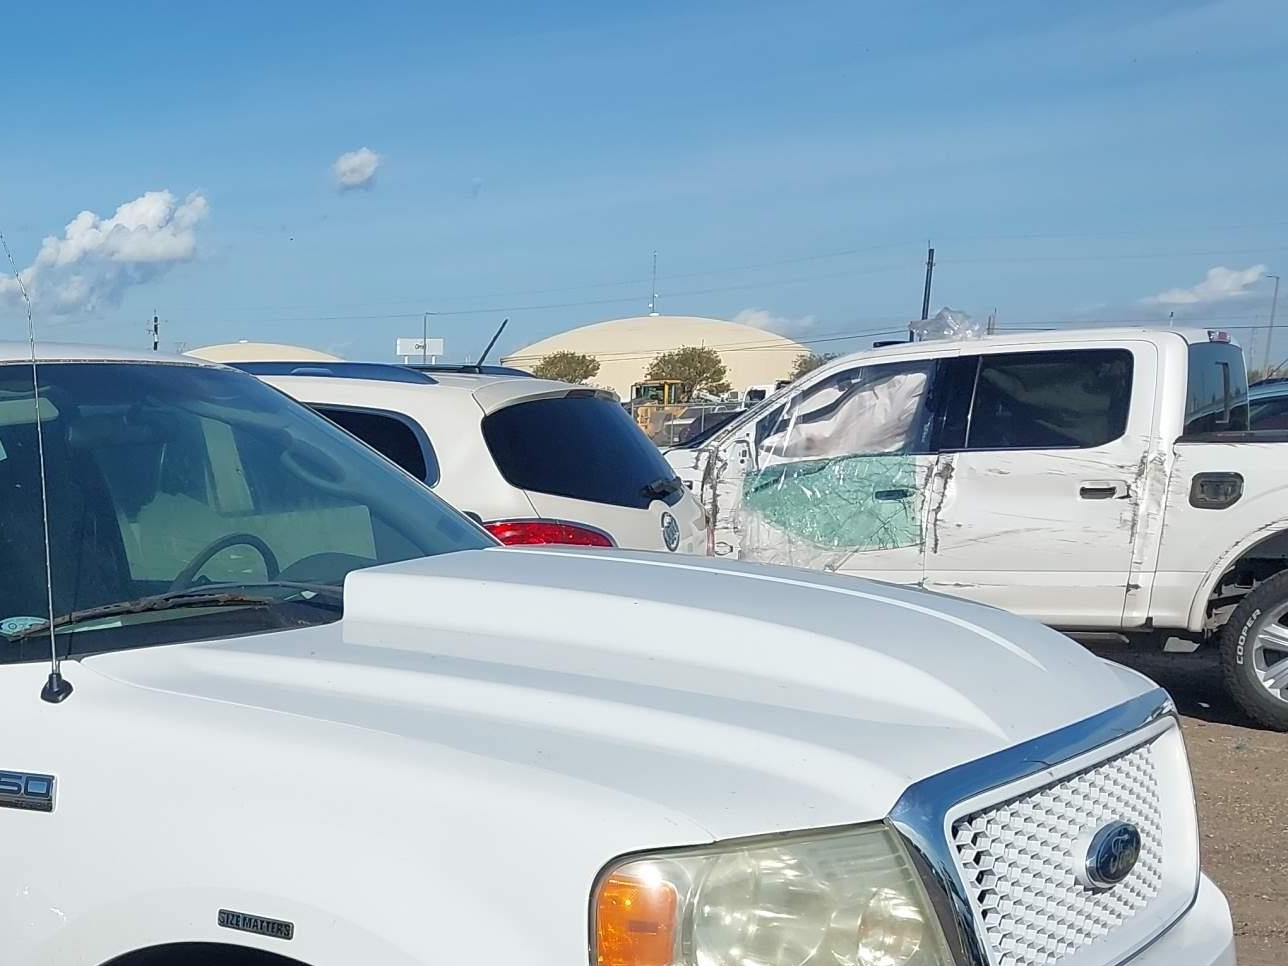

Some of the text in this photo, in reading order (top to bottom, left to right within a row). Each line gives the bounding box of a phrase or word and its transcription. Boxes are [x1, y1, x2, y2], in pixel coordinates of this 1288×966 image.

[1235, 608, 1262, 665] COOPER
[218, 911, 291, 937] SIZE MATTERS
